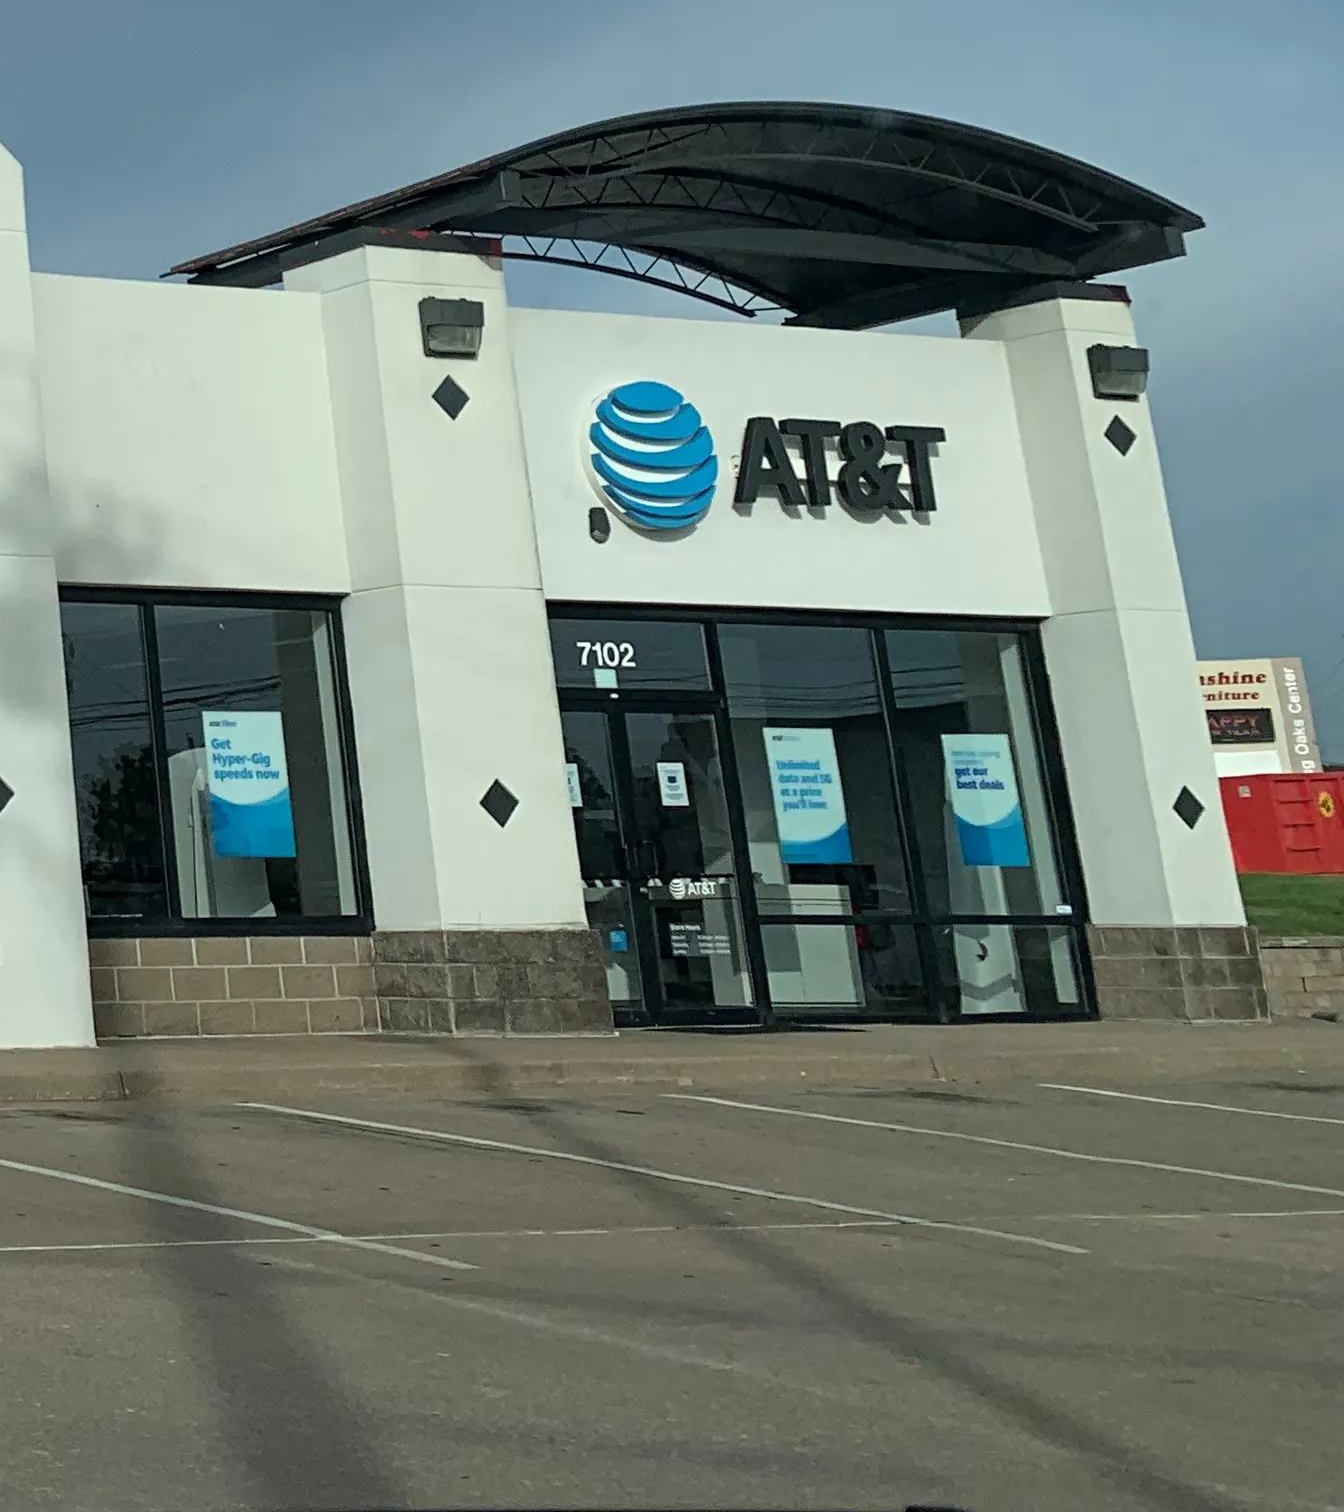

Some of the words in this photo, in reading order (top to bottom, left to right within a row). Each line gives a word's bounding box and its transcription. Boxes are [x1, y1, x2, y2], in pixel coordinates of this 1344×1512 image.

[734, 416, 946, 512] AT&T
[576, 641, 637, 667] 7102
[1199, 672, 1267, 686] shine
[1203, 691, 1260, 701] niture
[1283, 667, 1303, 714] Center
[211, 738, 231, 749] Get
[1292, 718, 1310, 755] Oaks
[212, 752, 271, 767] Hyper-Gig
[214, 767, 253, 782] speeds
[255, 770, 280, 780] now
[687, 881, 717, 895] AT&T
